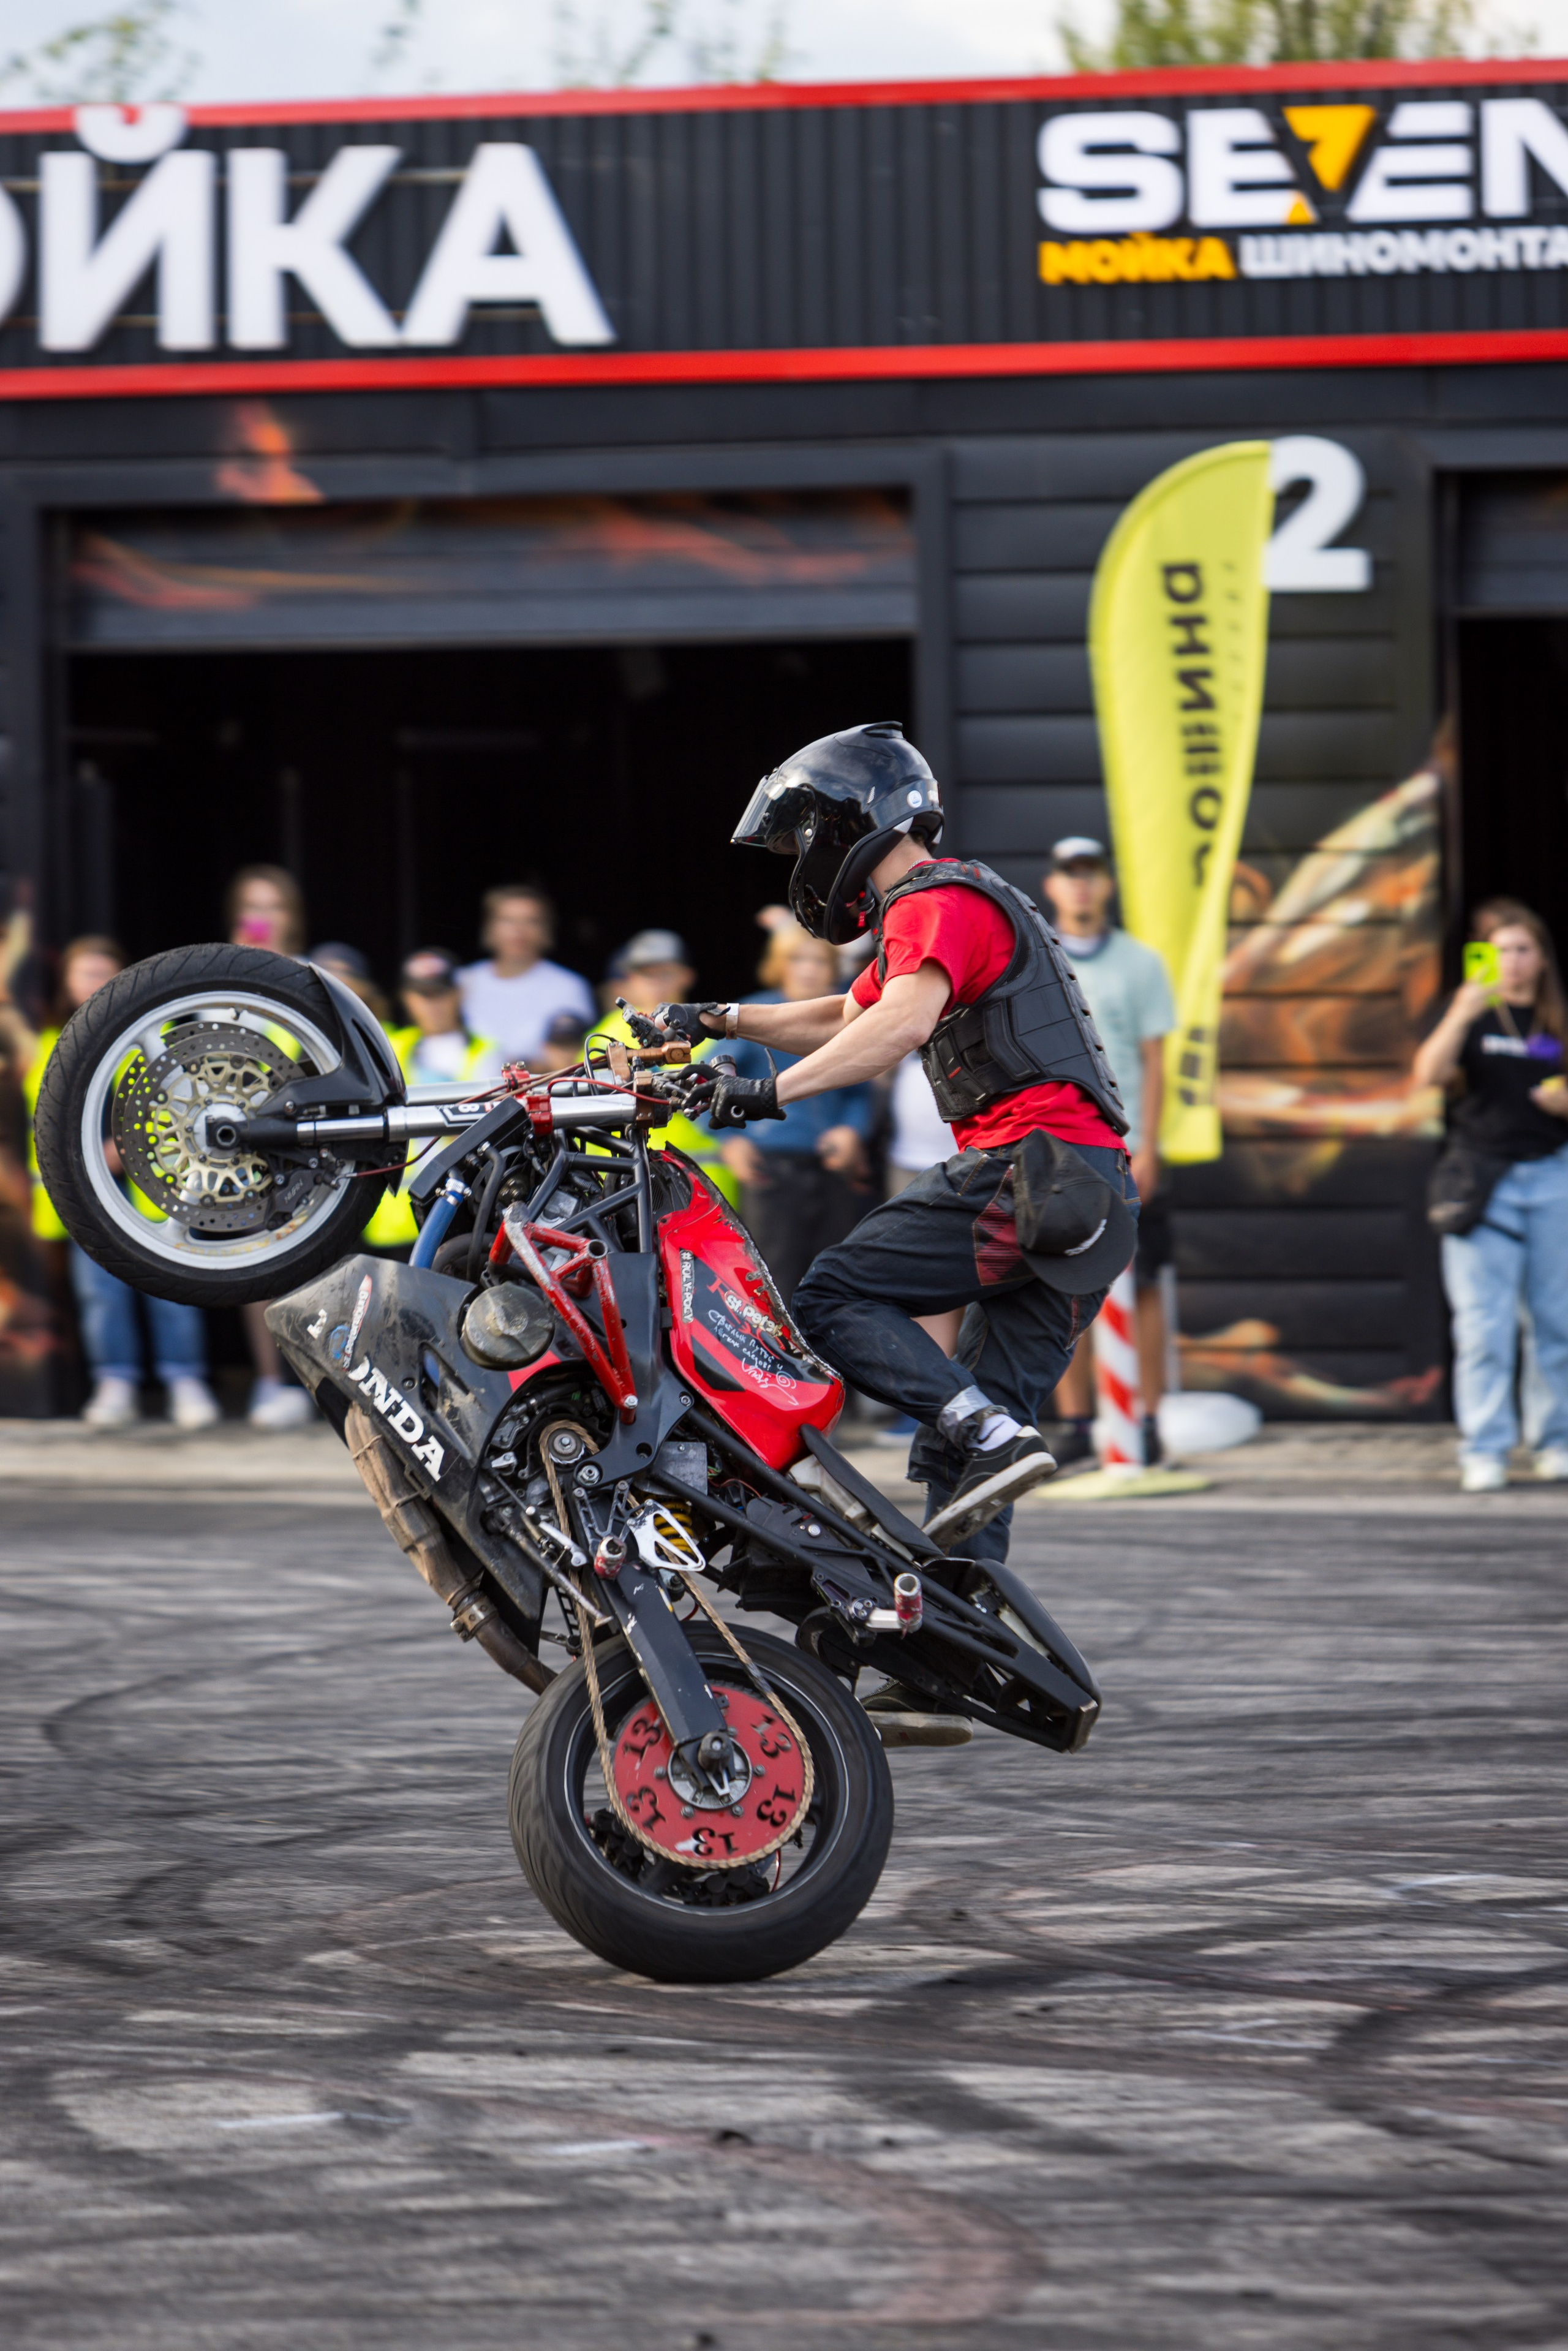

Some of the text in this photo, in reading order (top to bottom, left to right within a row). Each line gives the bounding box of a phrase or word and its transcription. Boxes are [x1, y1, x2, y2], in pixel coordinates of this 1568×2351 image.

[0, 103, 616, 352] ЙКА
[1039, 232, 1236, 284] МОЙКА
[1263, 434, 1372, 592] 2
[625, 1786, 667, 1833] 13
[756, 1784, 797, 1828] 13
[692, 1826, 739, 1857] 13
